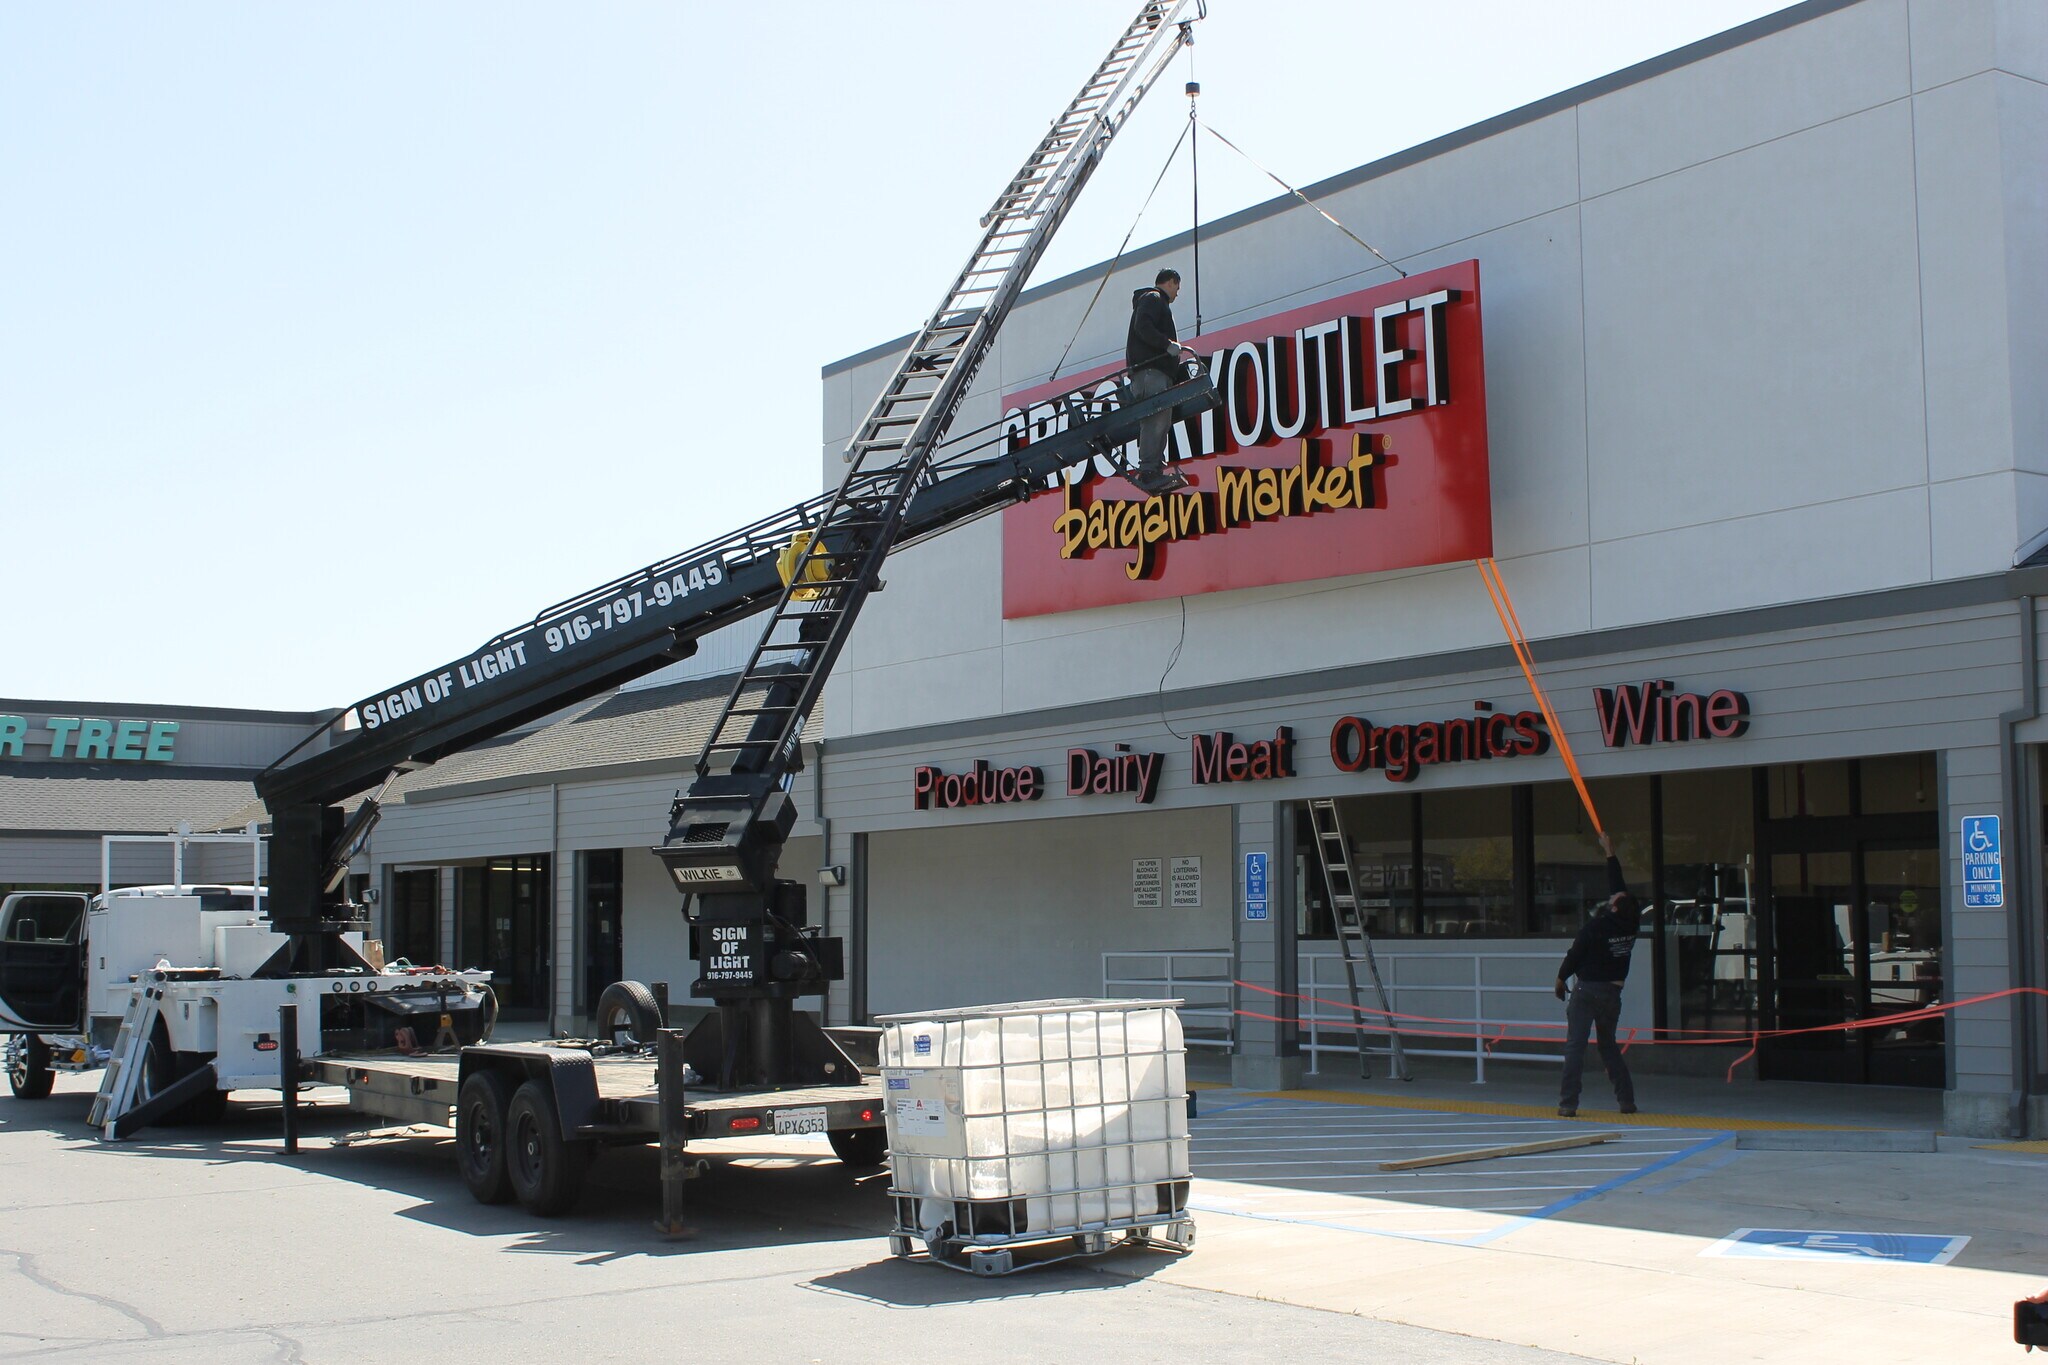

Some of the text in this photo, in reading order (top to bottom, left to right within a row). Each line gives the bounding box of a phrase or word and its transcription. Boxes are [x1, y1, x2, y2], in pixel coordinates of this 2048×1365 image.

[363, 559, 723, 730] SIGN OF LIGHT 916-797-9445
[46, 717, 180, 761] TREE
[914, 680, 1749, 810] Produce Dairy Meat Organics Wine
[1965, 851, 2000, 865] PARKING
[680, 868, 722, 881] WILKIE
[1972, 866, 1993, 879] ONLY
[1970, 884, 1995, 893] MINIMUM
[1967, 895, 1980, 904] FINE
[712, 926, 747, 940] SIGN
[721, 941, 738, 954] OF
[710, 956, 750, 969] LIGHT
[707, 971, 753, 980] 916-797-9445
[778, 1118, 824, 1134] 4PX6353
